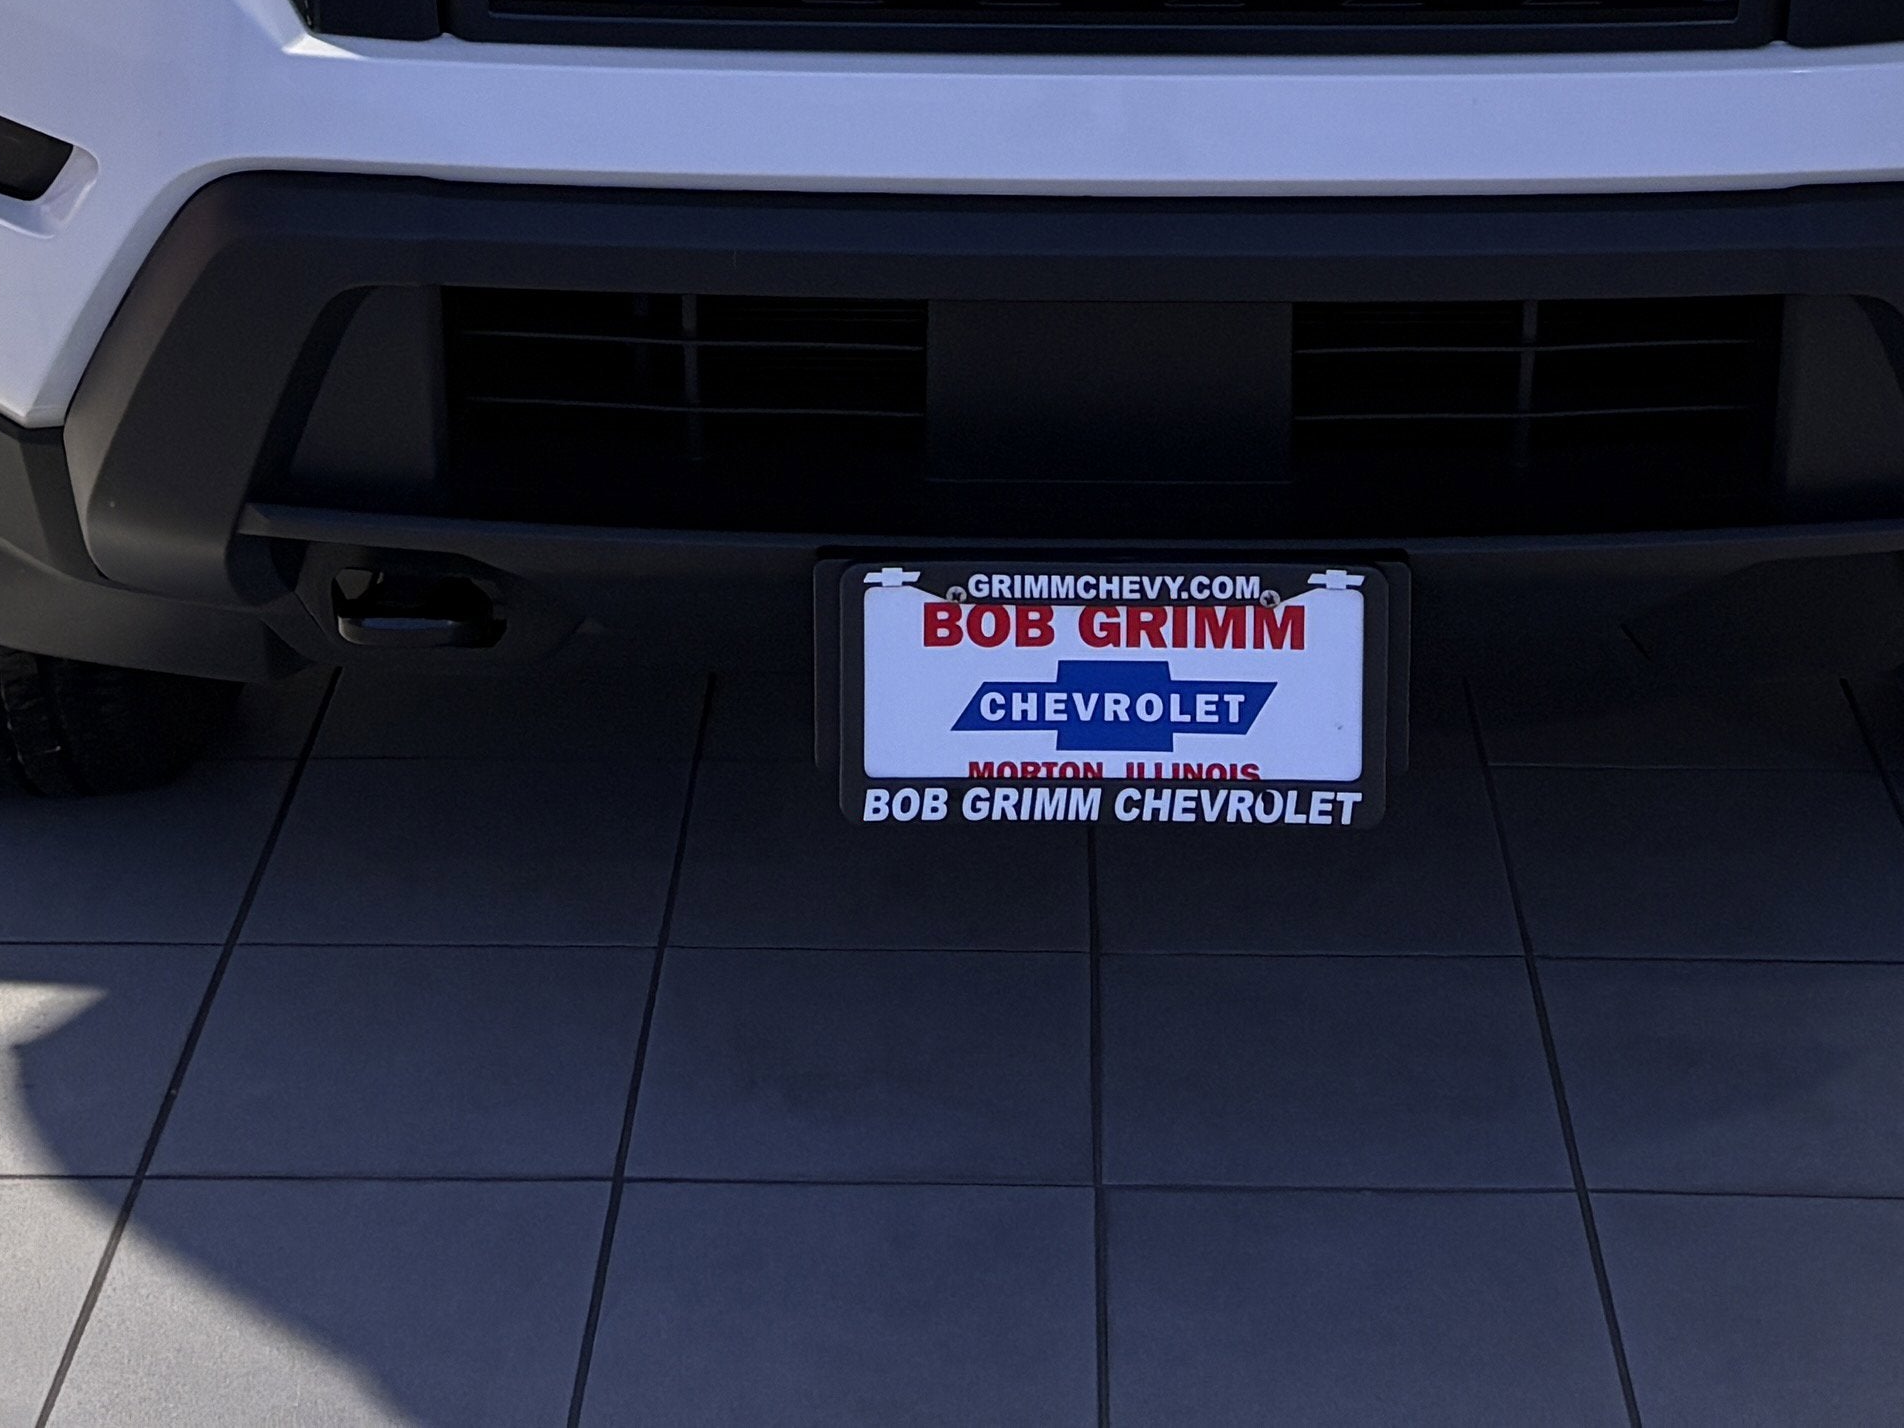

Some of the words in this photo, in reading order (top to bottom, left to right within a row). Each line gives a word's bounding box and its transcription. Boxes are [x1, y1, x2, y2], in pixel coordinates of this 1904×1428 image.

[967, 573, 1260, 600] GRIMMCHEVY.COM
[922, 603, 1055, 647] BOB
[1077, 604, 1306, 650] GRIMM
[979, 691, 1247, 723] CHEVROLET
[863, 787, 948, 822] BOB
[962, 787, 1102, 822] GRIMM
[1114, 787, 1363, 825] CHEVROLET
